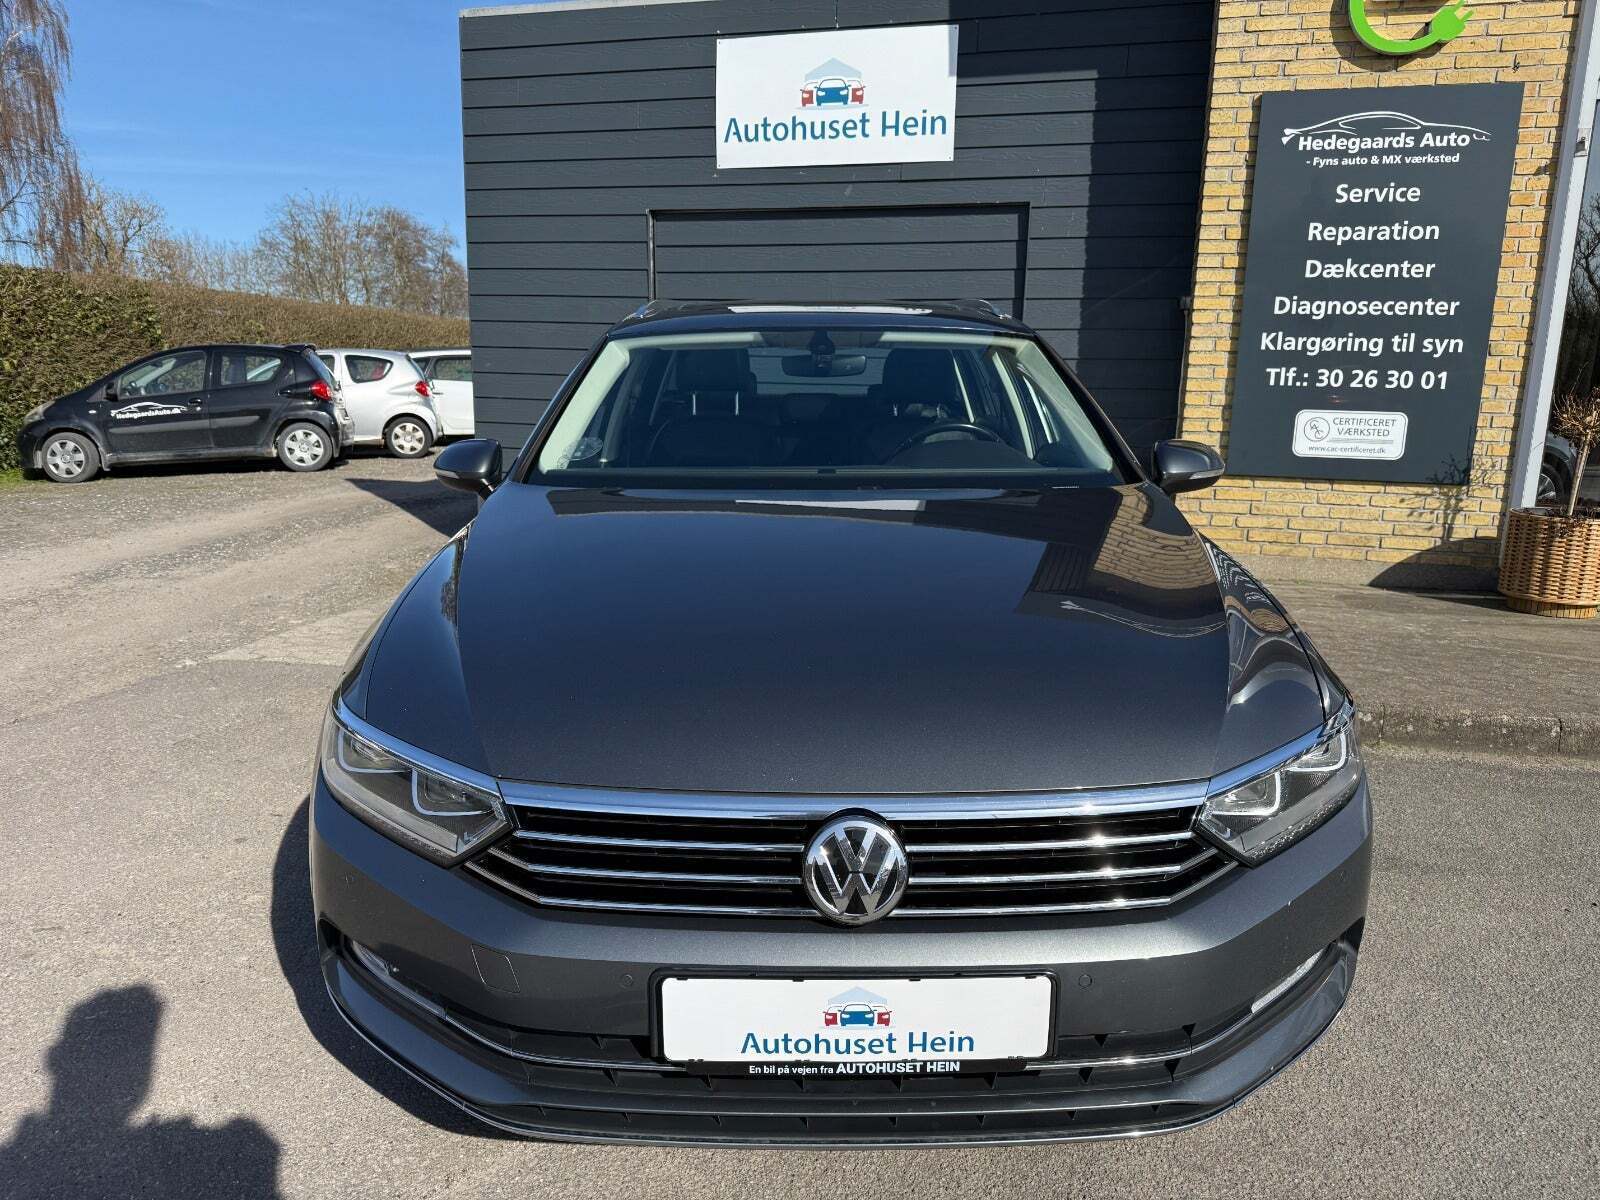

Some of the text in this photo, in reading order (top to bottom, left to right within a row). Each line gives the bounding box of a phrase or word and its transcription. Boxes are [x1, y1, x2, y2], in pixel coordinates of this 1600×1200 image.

[723, 109, 948, 143] Autohuset Hein
[1299, 132, 1471, 153] Hedegaards Auto
[1312, 157, 1339, 168] Fyns
[1341, 155, 1368, 166] auto
[1370, 155, 1380, 165] &
[1382, 154, 1402, 165] MX
[1404, 153, 1460, 164] værksted
[1335, 183, 1421, 203] Service
[1308, 221, 1440, 246] Reparation
[1304, 258, 1436, 278] Dækcenter
[1273, 295, 1460, 320] Diagnosecenter
[1261, 332, 1464, 358] Klargøring til syn
[1266, 368, 1448, 389] Tlf.: 30 26 30 01
[1332, 417, 1397, 427] CERTIFICERET
[1337, 427, 1390, 437] VÆRKSTED
[740, 1031, 975, 1055] Autohuset Hein
[749, 1061, 960, 1076] En bil på vejen fra AUTOHUSET HEIN
